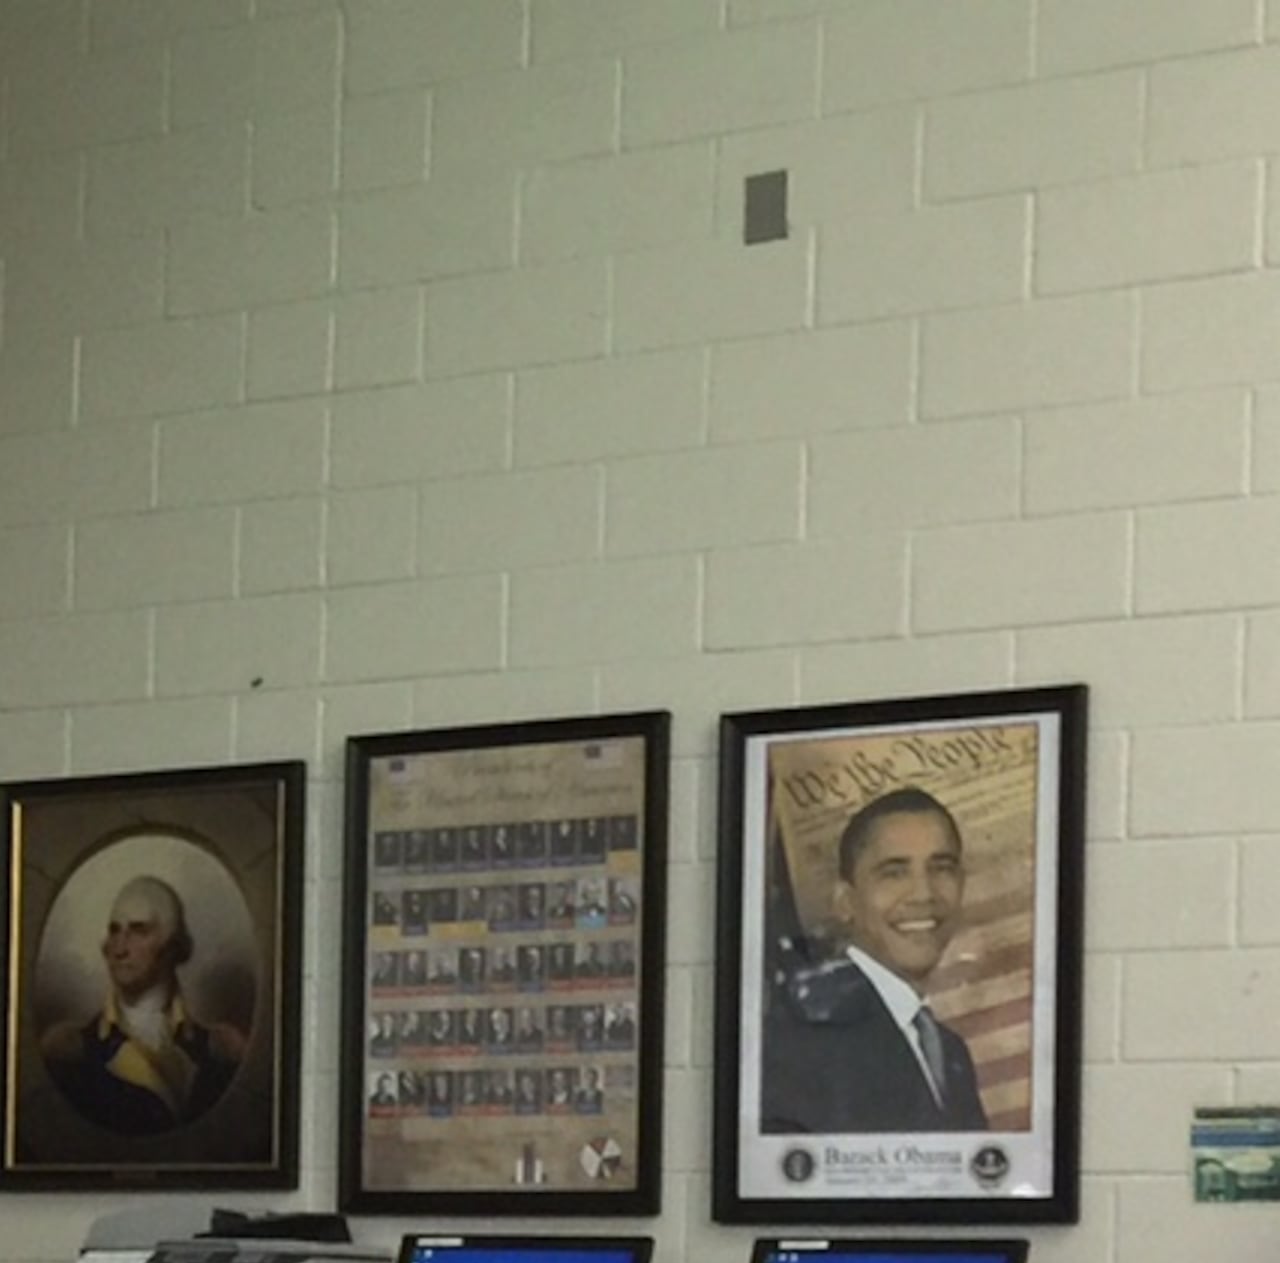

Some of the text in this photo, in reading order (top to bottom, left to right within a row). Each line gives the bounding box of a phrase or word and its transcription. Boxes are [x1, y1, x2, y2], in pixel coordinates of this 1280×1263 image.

[784, 725, 1011, 809] We the People
